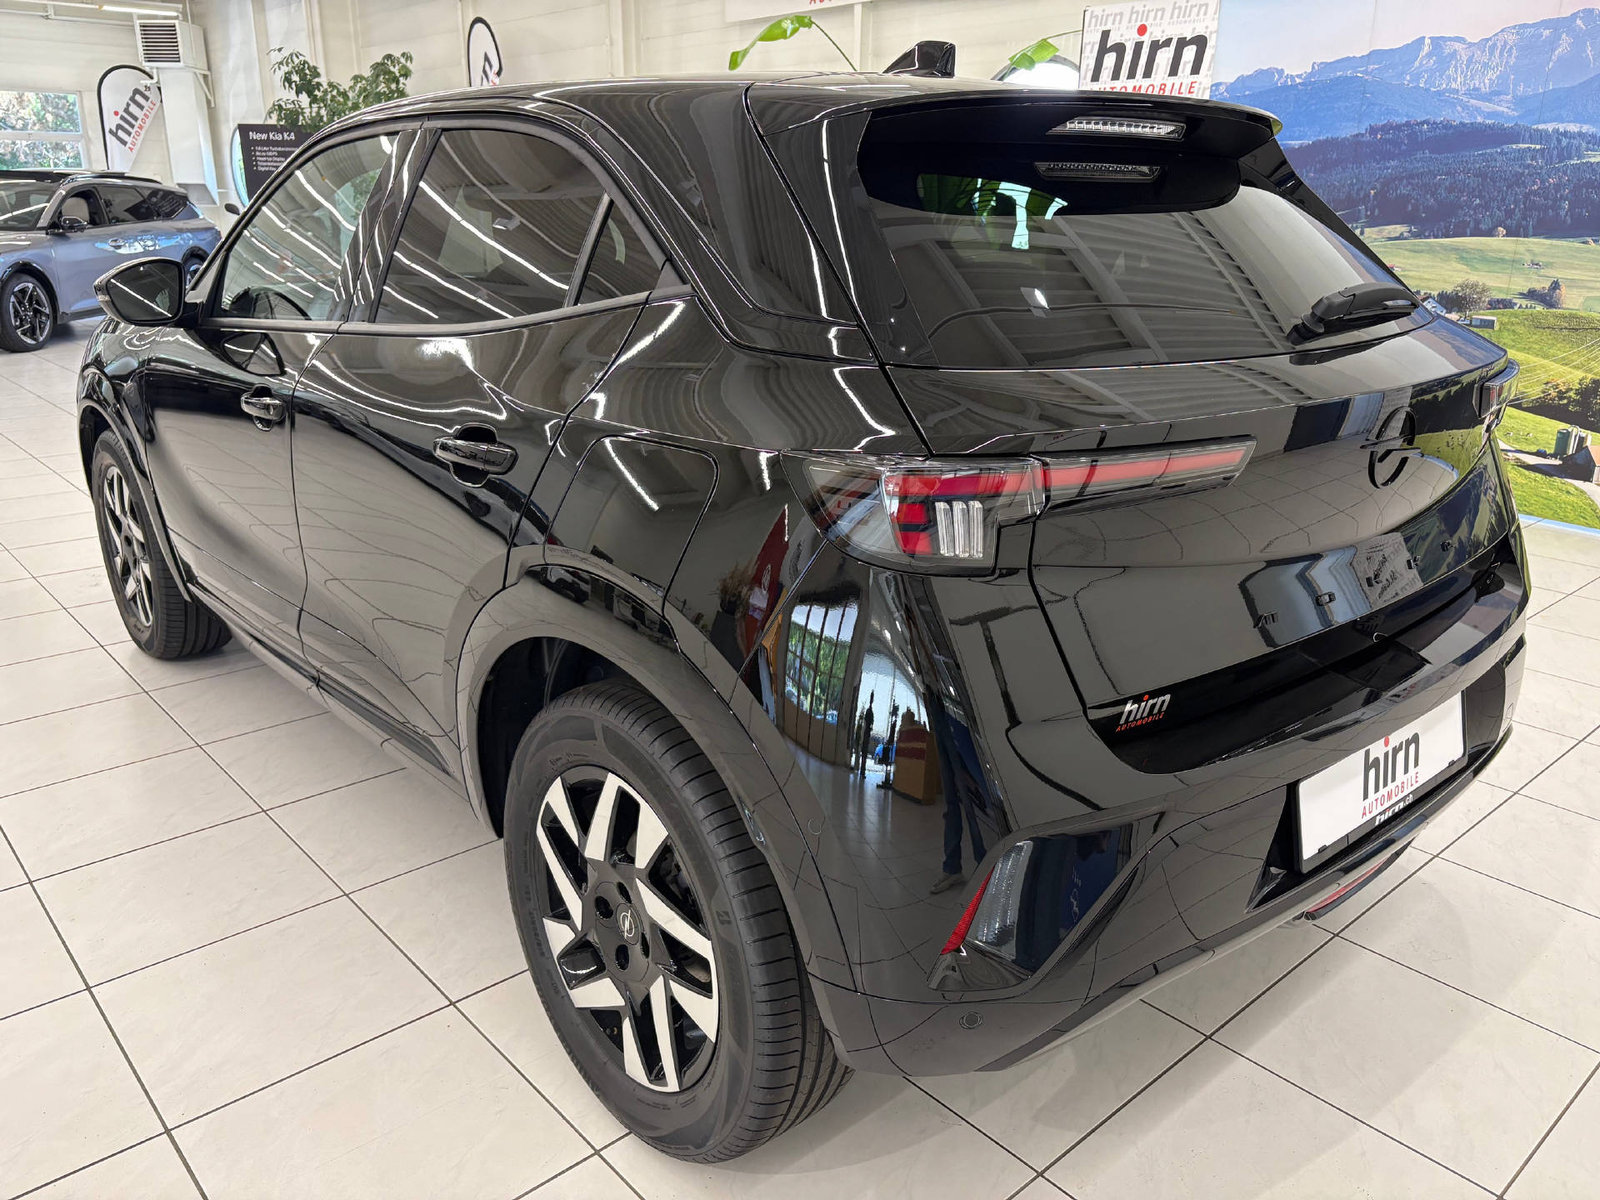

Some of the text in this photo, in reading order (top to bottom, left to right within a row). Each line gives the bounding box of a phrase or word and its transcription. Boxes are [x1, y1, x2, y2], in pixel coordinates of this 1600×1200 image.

[1087, 0, 1209, 28] hirn hirn hirn
[1090, 24, 1208, 82] hirn
[1090, 81, 1198, 95] MOBILE
[108, 87, 150, 147] hirn
[128, 100, 156, 152] AUTOMOBILE
[249, 131, 267, 141] New
[269, 131, 283, 141] Kia
[1115, 711, 1165, 733] AUTOMOBILE
[1119, 694, 1171, 724] hirn
[1363, 732, 1420, 801] hirn
[1361, 772, 1419, 819] AUTOMOBILE
